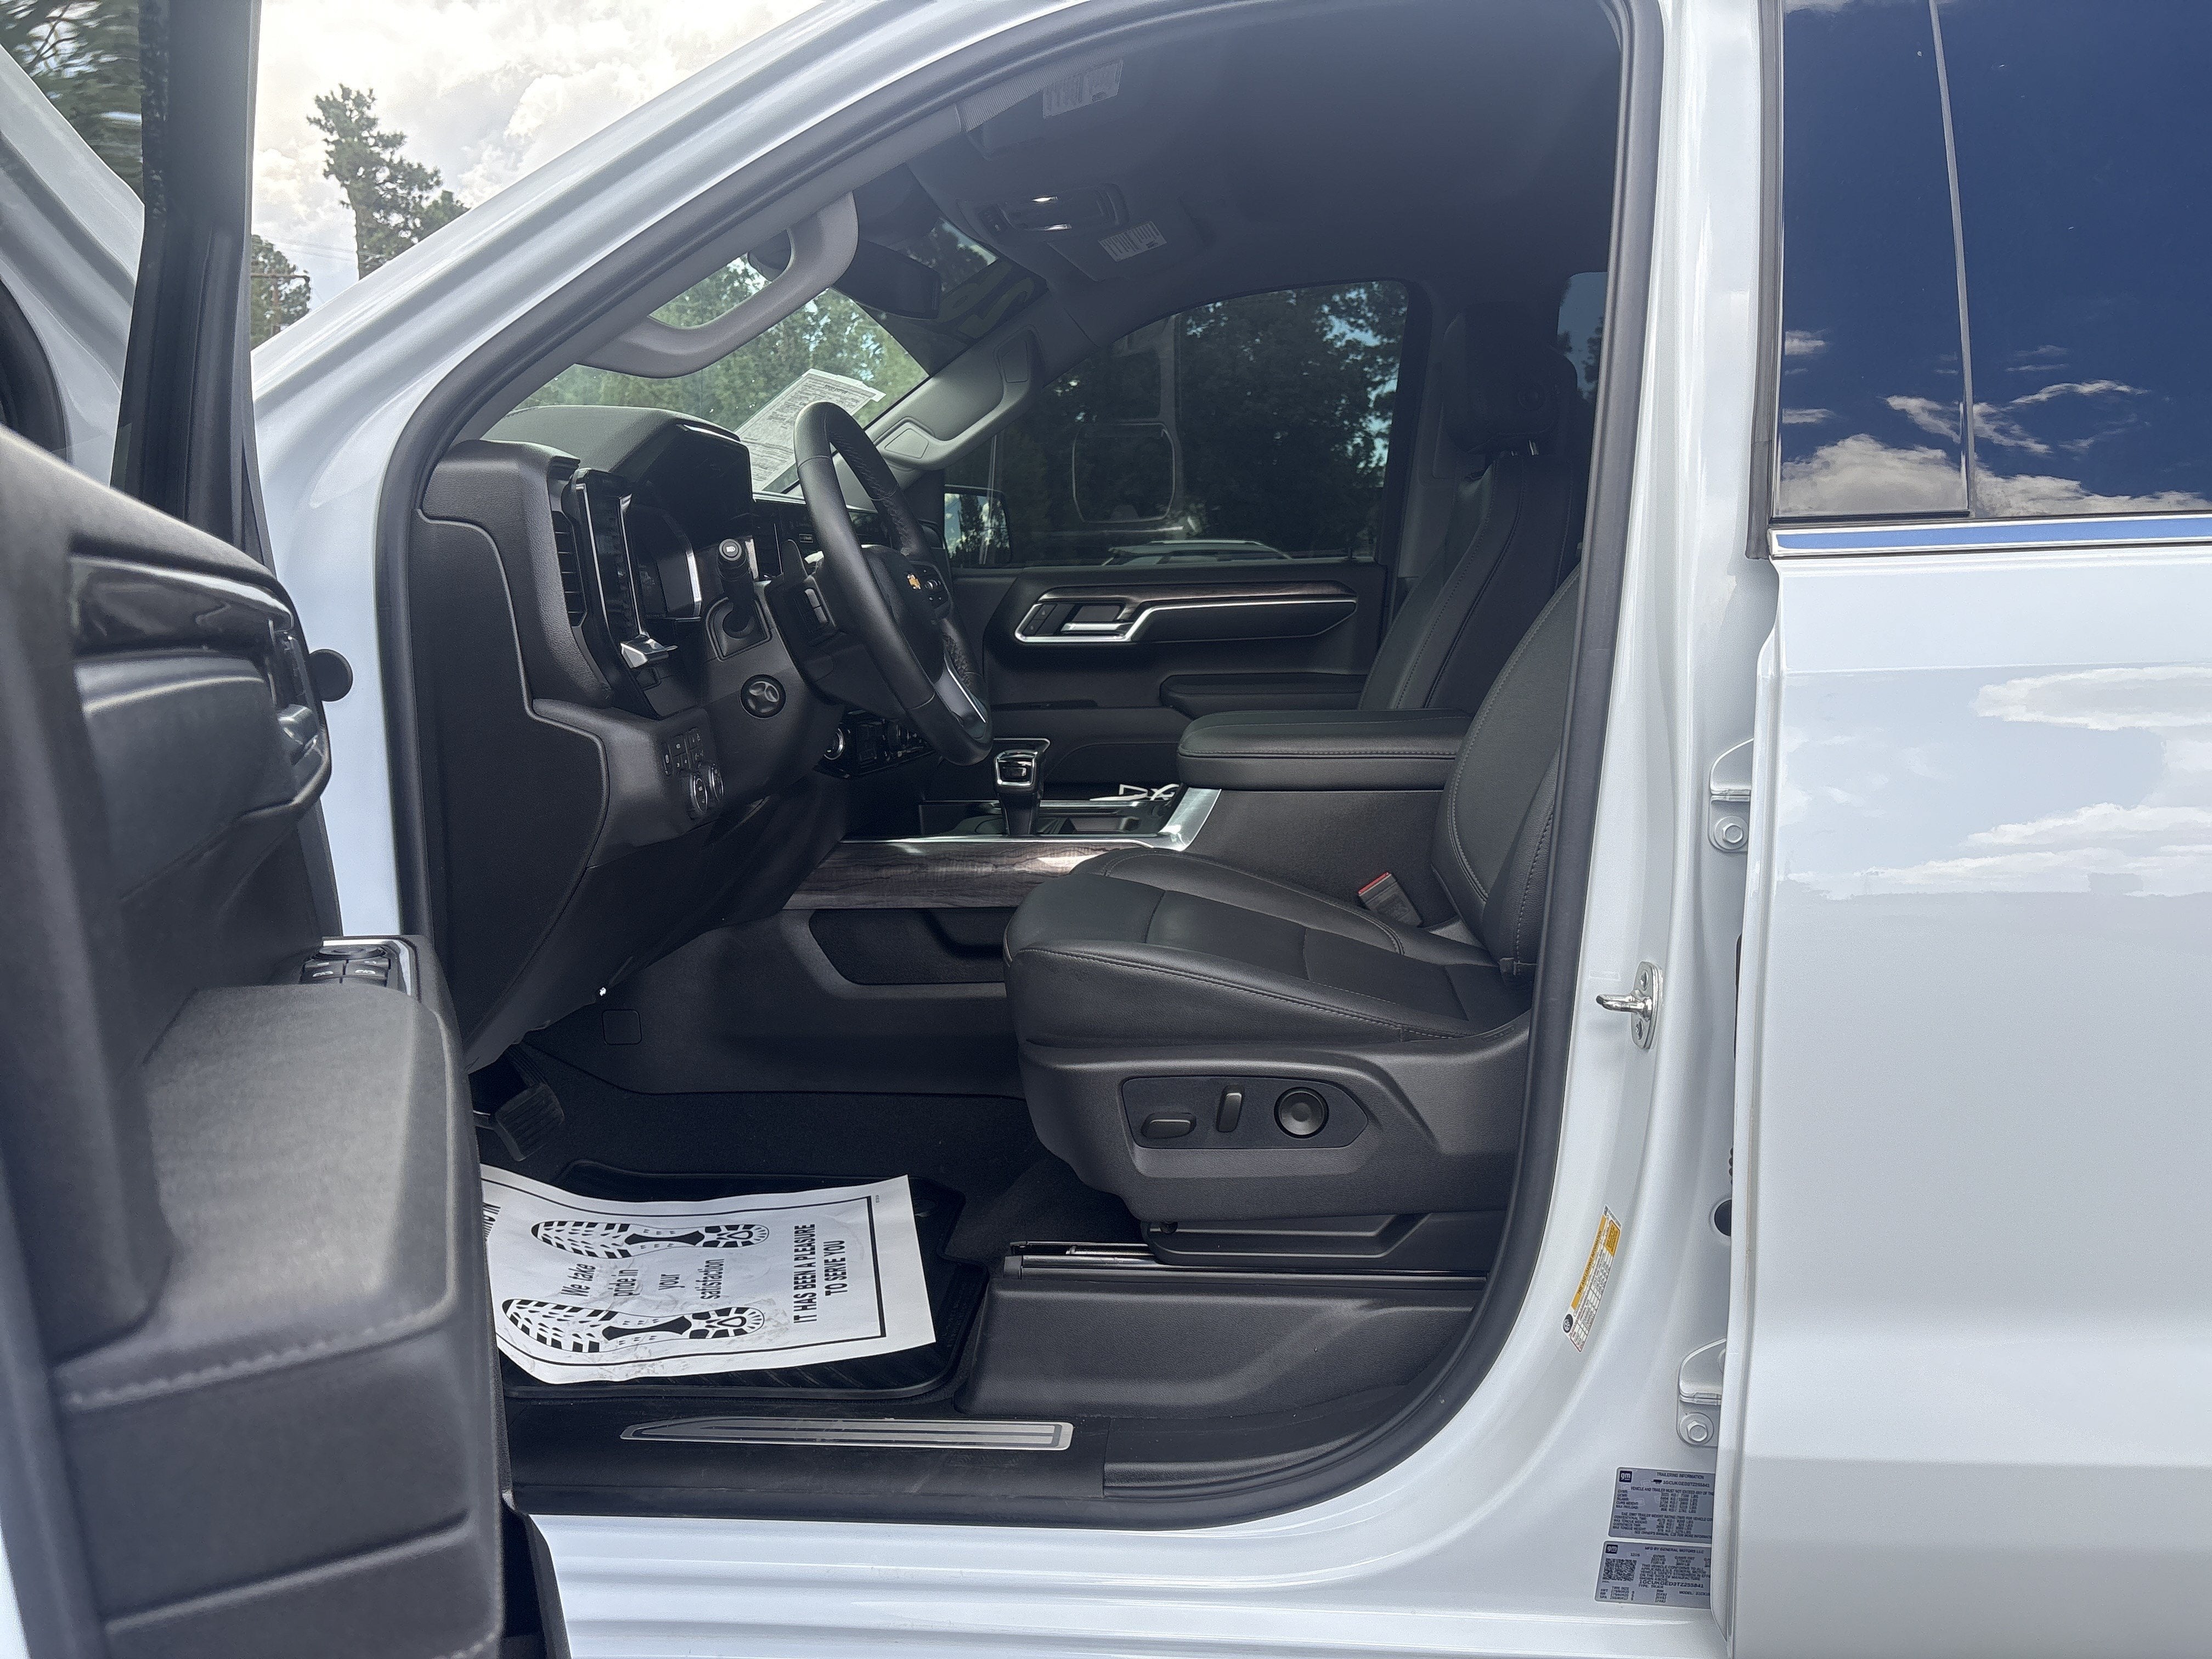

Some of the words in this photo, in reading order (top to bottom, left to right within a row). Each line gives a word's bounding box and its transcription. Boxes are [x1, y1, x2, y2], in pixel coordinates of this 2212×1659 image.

[793, 1223, 816, 1261] PLEASURE
[823, 1240, 845, 1257] YOU
[567, 1263, 596, 1282] take
[611, 1269, 639, 1277] in
[824, 1257, 848, 1282] SERVE
[1584, 1256, 1593, 1277] LOADING
[607, 1278, 640, 1297] pride
[658, 1274, 686, 1291] your
[694, 1258, 725, 1300] satisfaction
[793, 1269, 816, 1290] BEEN
[560, 1284, 591, 1297] We
[825, 1283, 848, 1296] TO
[793, 1293, 817, 1312] HAS
[793, 1314, 817, 1324] IT
